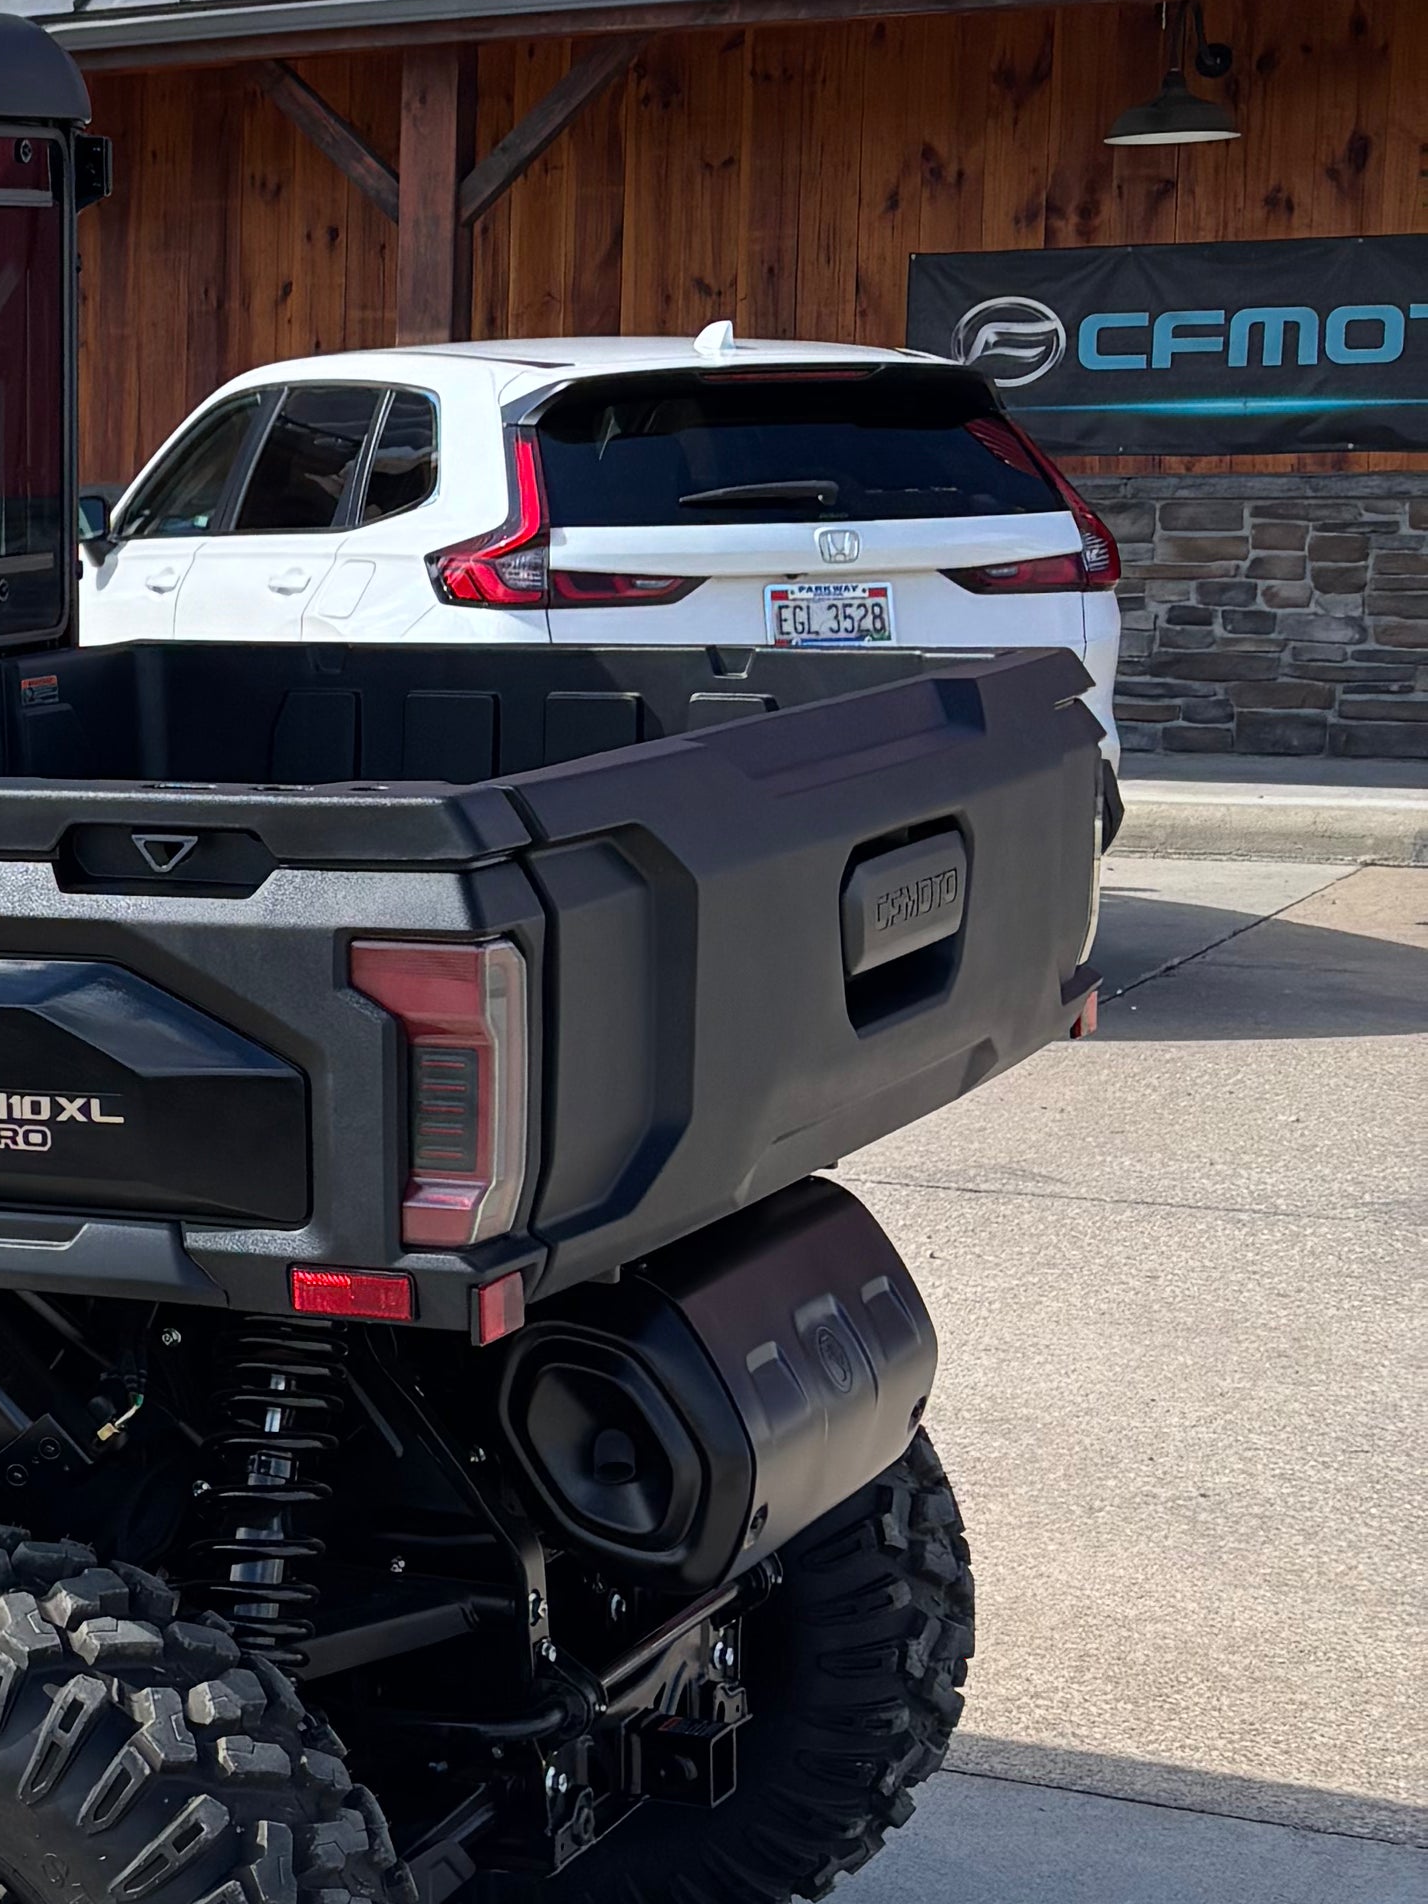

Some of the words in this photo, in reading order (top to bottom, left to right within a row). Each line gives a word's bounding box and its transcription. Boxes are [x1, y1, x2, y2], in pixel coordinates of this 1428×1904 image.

[1078, 303, 1428, 371] CFMO
[797, 584, 859, 594] PARKWAY
[777, 604, 819, 636] EGL
[826, 602, 886, 634] 3528
